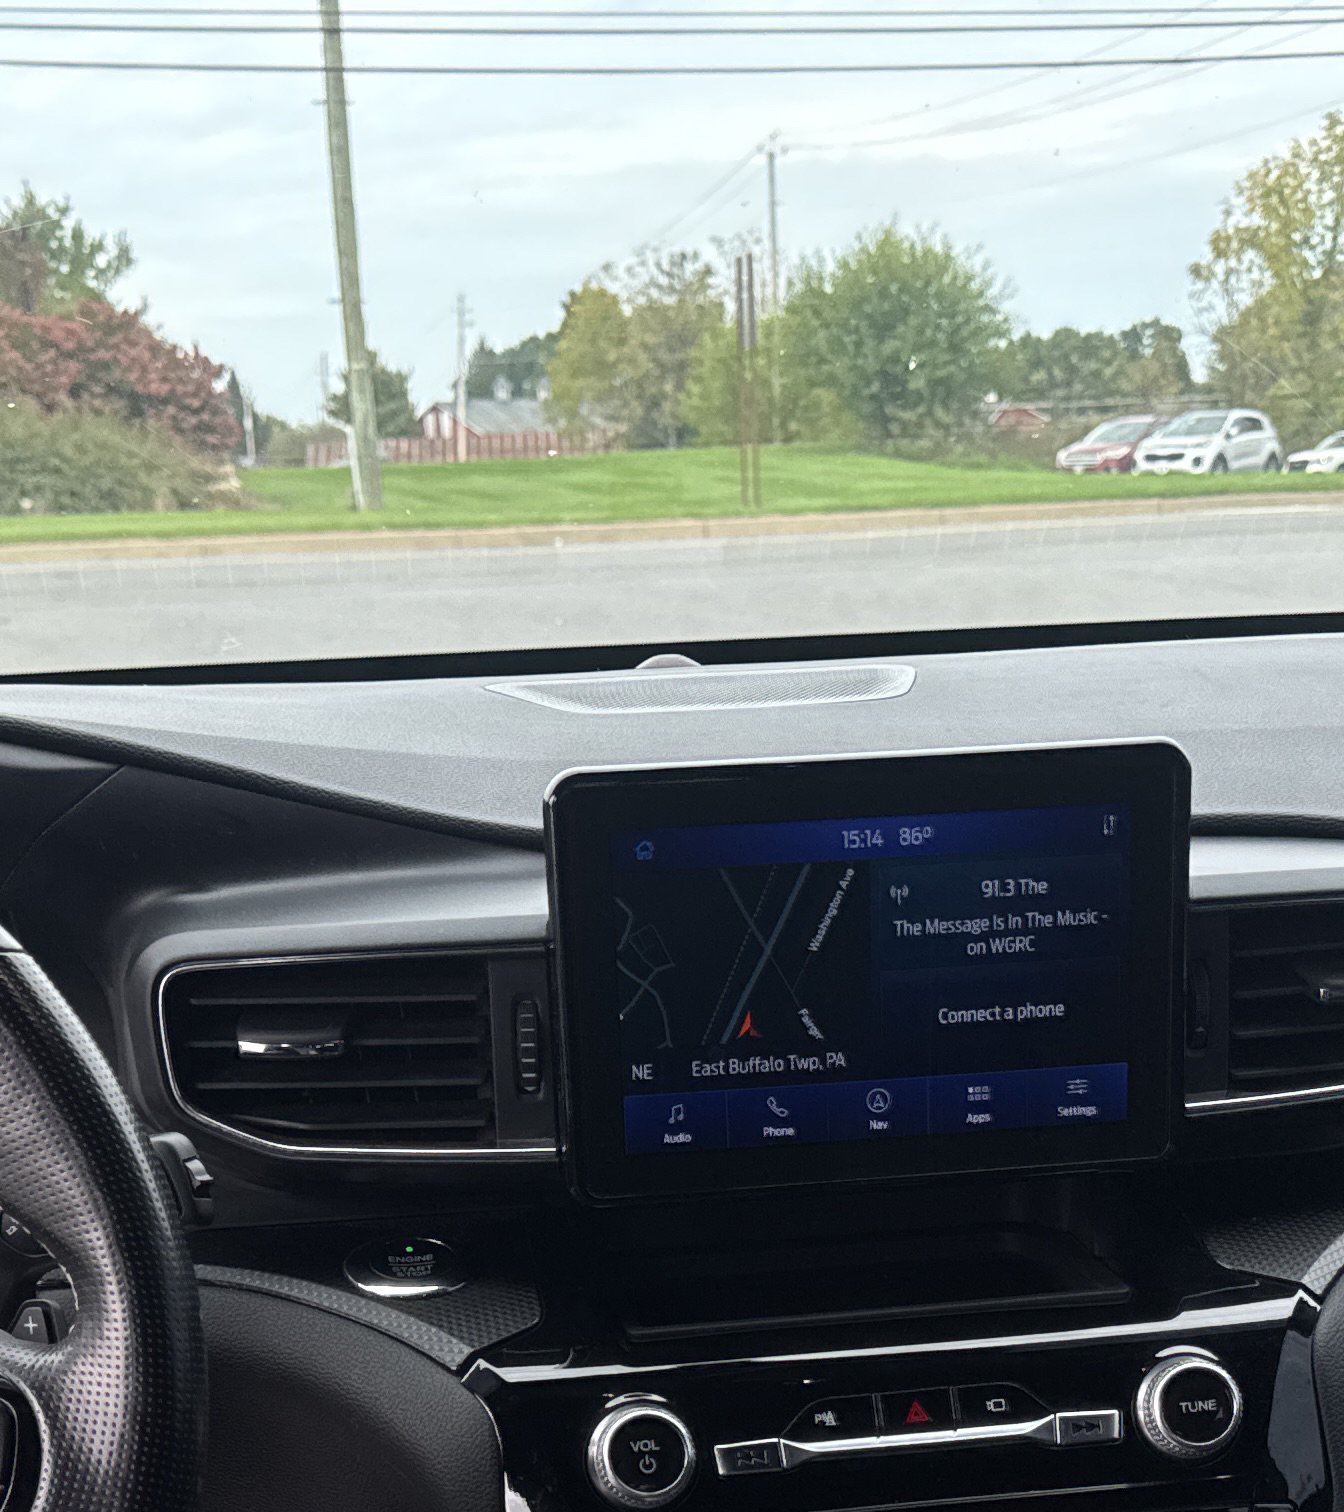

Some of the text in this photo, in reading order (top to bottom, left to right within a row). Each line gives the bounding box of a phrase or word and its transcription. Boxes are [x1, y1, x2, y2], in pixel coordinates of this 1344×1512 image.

[841, 829, 884, 849] 15:14
[981, 877, 1049, 898] 91.3 The
[808, 889, 845, 951] Washington
[892, 919, 922, 936] The
[925, 917, 989, 936] Message
[993, 913, 1005, 931] Is
[1008, 912, 1023, 930] In
[1025, 911, 1053, 929] The
[1056, 907, 1099, 926] Music
[967, 935, 1036, 956] on WGRC
[938, 1002, 1065, 1025] Connect a phone
[691, 1060, 725, 1077] East
[728, 1056, 785, 1075] Buffalo
[826, 1052, 846, 1068] PA
[631, 1063, 653, 1081] NE
[1057, 1104, 1098, 1118] Settings
[869, 1119, 889, 1130] Nav
[966, 1112, 991, 1125] Apps
[663, 1132, 692, 1145] Audio
[763, 1125, 795, 1138] Phone
[387, 1253, 434, 1264] ENGINE
[391, 1264, 434, 1272] START
[396, 1270, 432, 1278] STOP
[1178, 1399, 1218, 1414] TUNE
[629, 1439, 660, 1453] VOL
